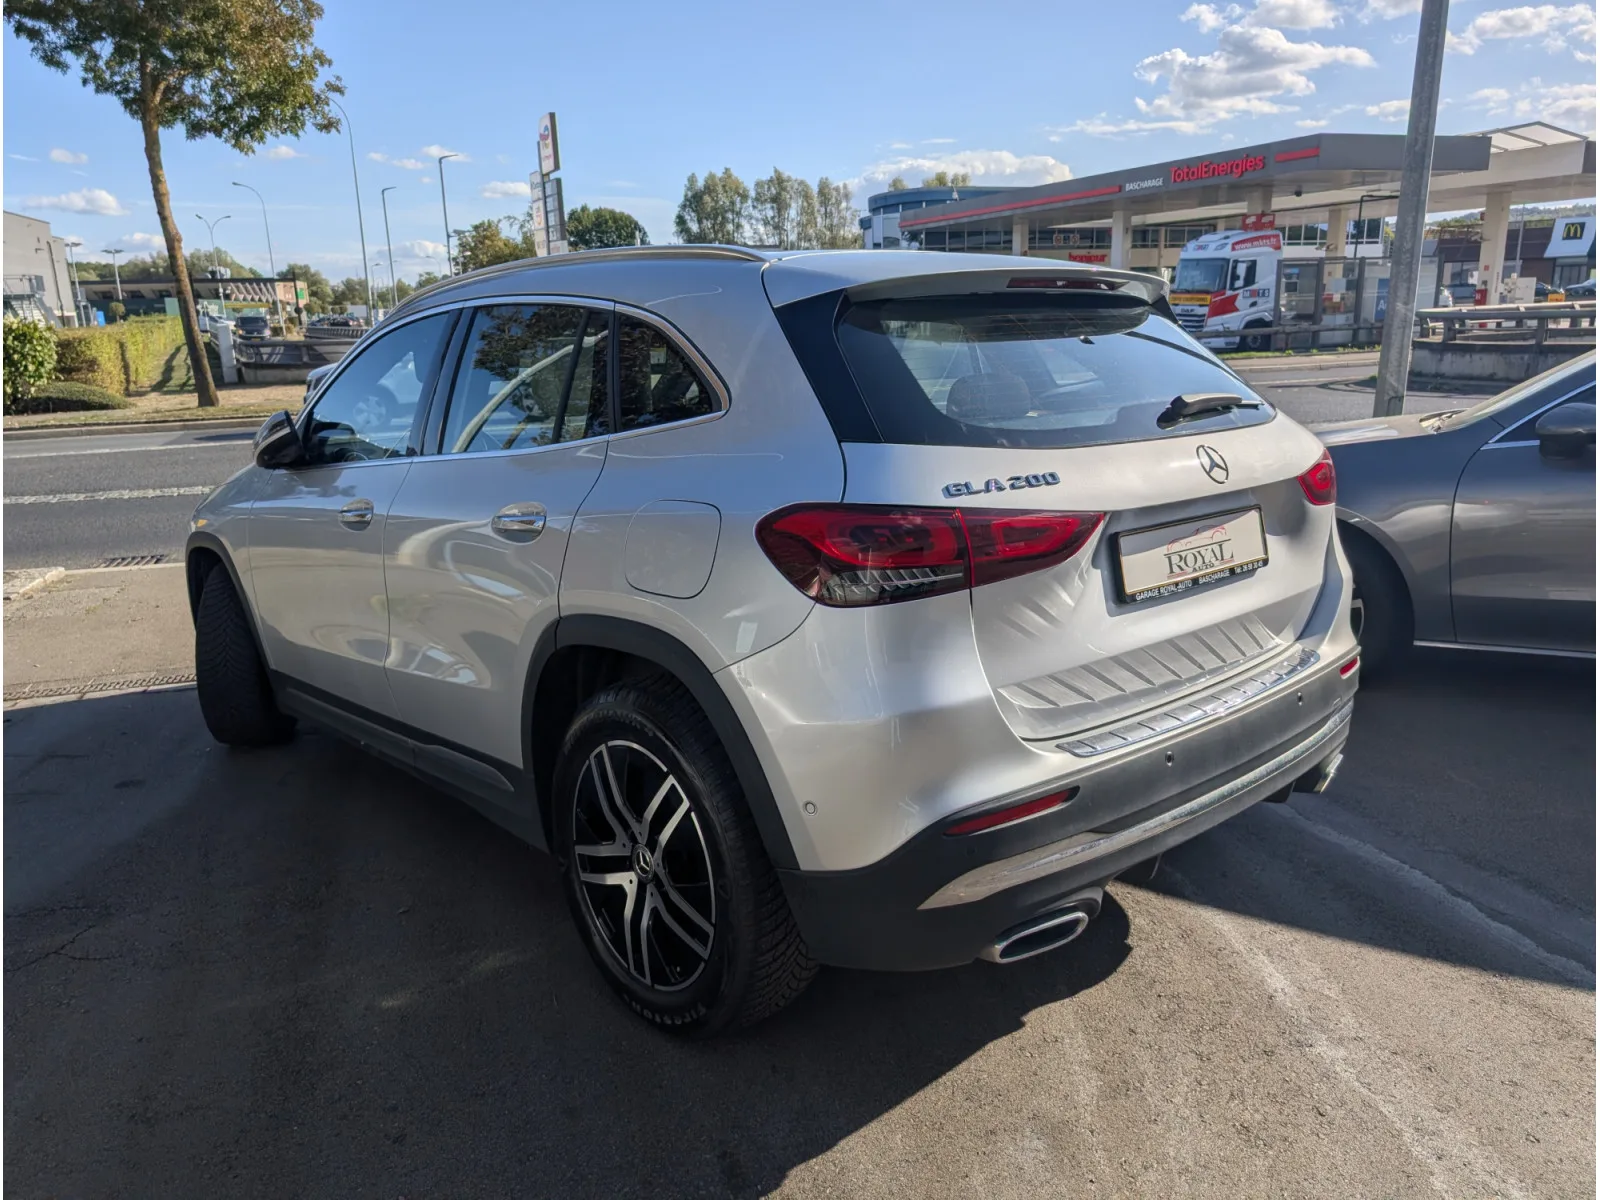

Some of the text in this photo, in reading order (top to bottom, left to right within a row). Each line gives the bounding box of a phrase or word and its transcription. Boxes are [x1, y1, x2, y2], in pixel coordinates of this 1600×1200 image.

[1125, 153, 1265, 192] BASCHARAGE TotalEnergies
[942, 471, 1061, 499] GLA 200
[1165, 543, 1234, 575] ROYAL
[1192, 562, 1215, 573] AUTO
[1135, 587, 1160, 601] GARAGE
[1198, 569, 1231, 584] BASCHARAGE
